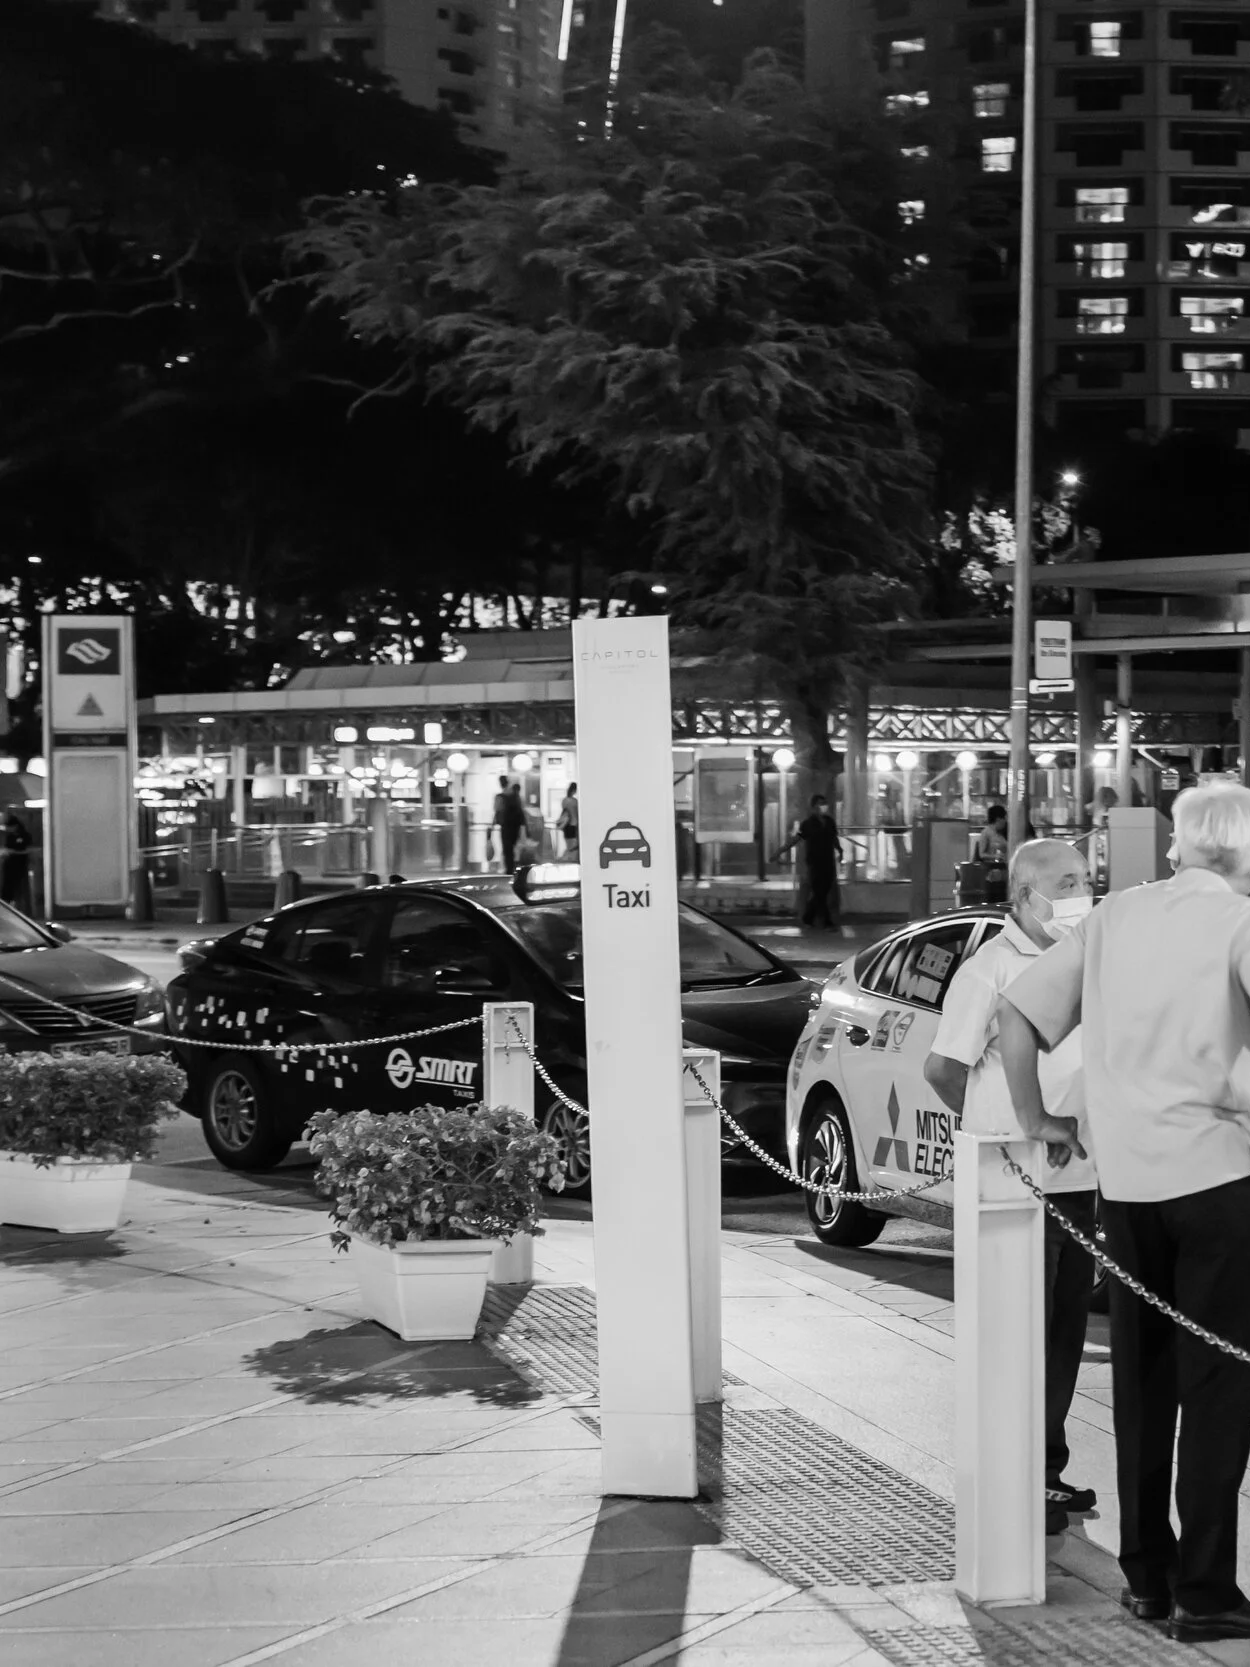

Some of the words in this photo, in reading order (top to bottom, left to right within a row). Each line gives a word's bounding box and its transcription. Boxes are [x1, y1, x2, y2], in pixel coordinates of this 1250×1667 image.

[581, 649, 658, 661] CAPITOL
[602, 883, 650, 908] Taxi
[415, 1056, 478, 1085] SMRT
[914, 1143, 954, 1177] ELEC
